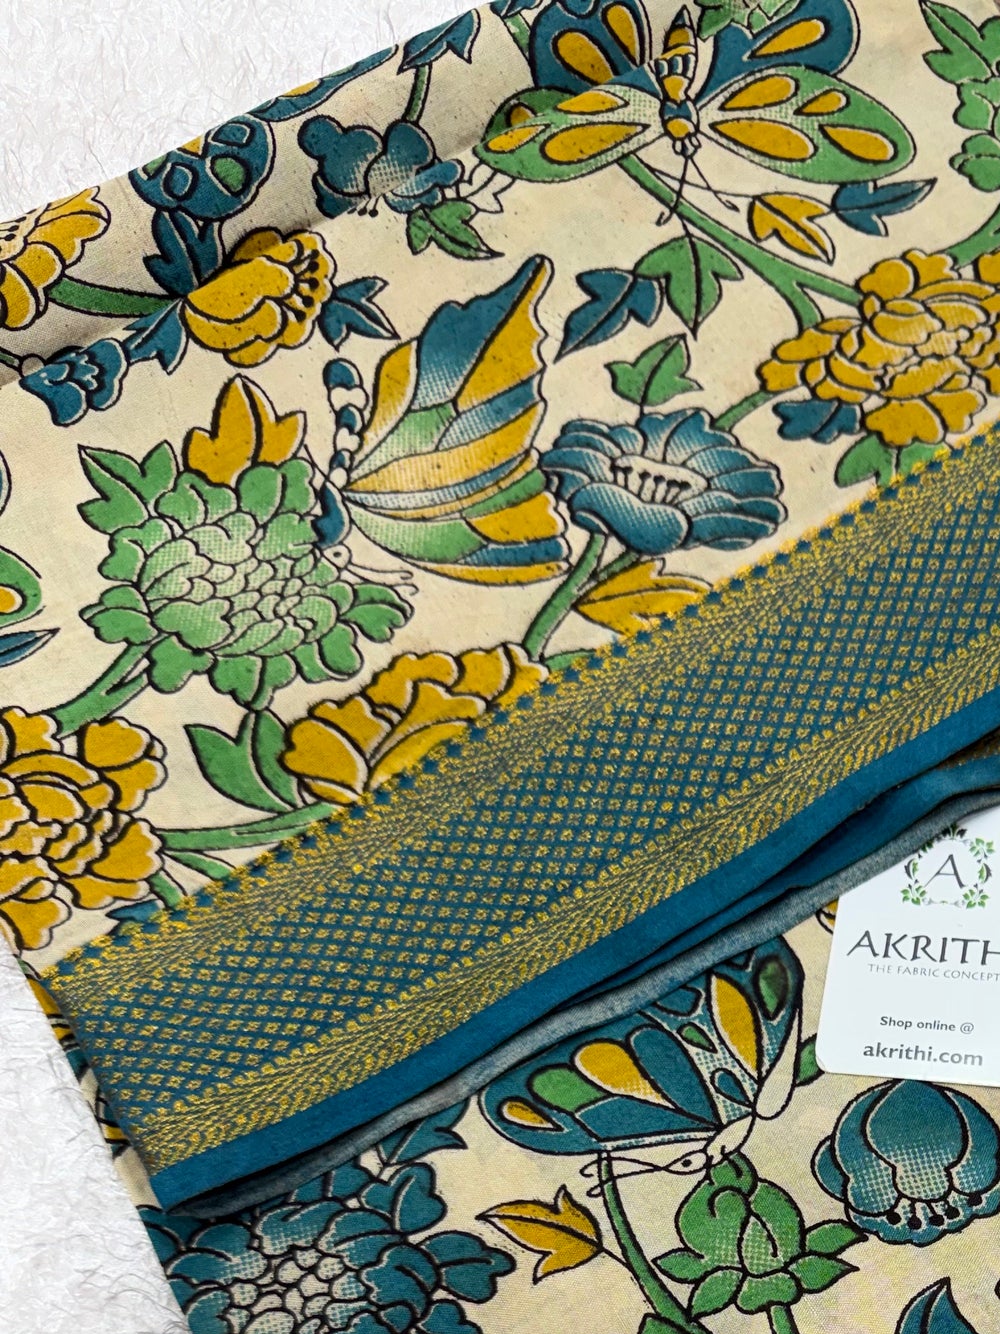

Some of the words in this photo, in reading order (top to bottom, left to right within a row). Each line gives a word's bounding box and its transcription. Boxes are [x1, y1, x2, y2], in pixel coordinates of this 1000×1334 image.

[867, 963, 893, 975] THE
[896, 965, 940, 978] FABRIC
[943, 969, 1000, 982] CONCEPT
[879, 1016, 912, 1030] Shop
[917, 1019, 956, 1032] online
[960, 1021, 975, 1035] @
[863, 1042, 984, 1067] akrithi.com
